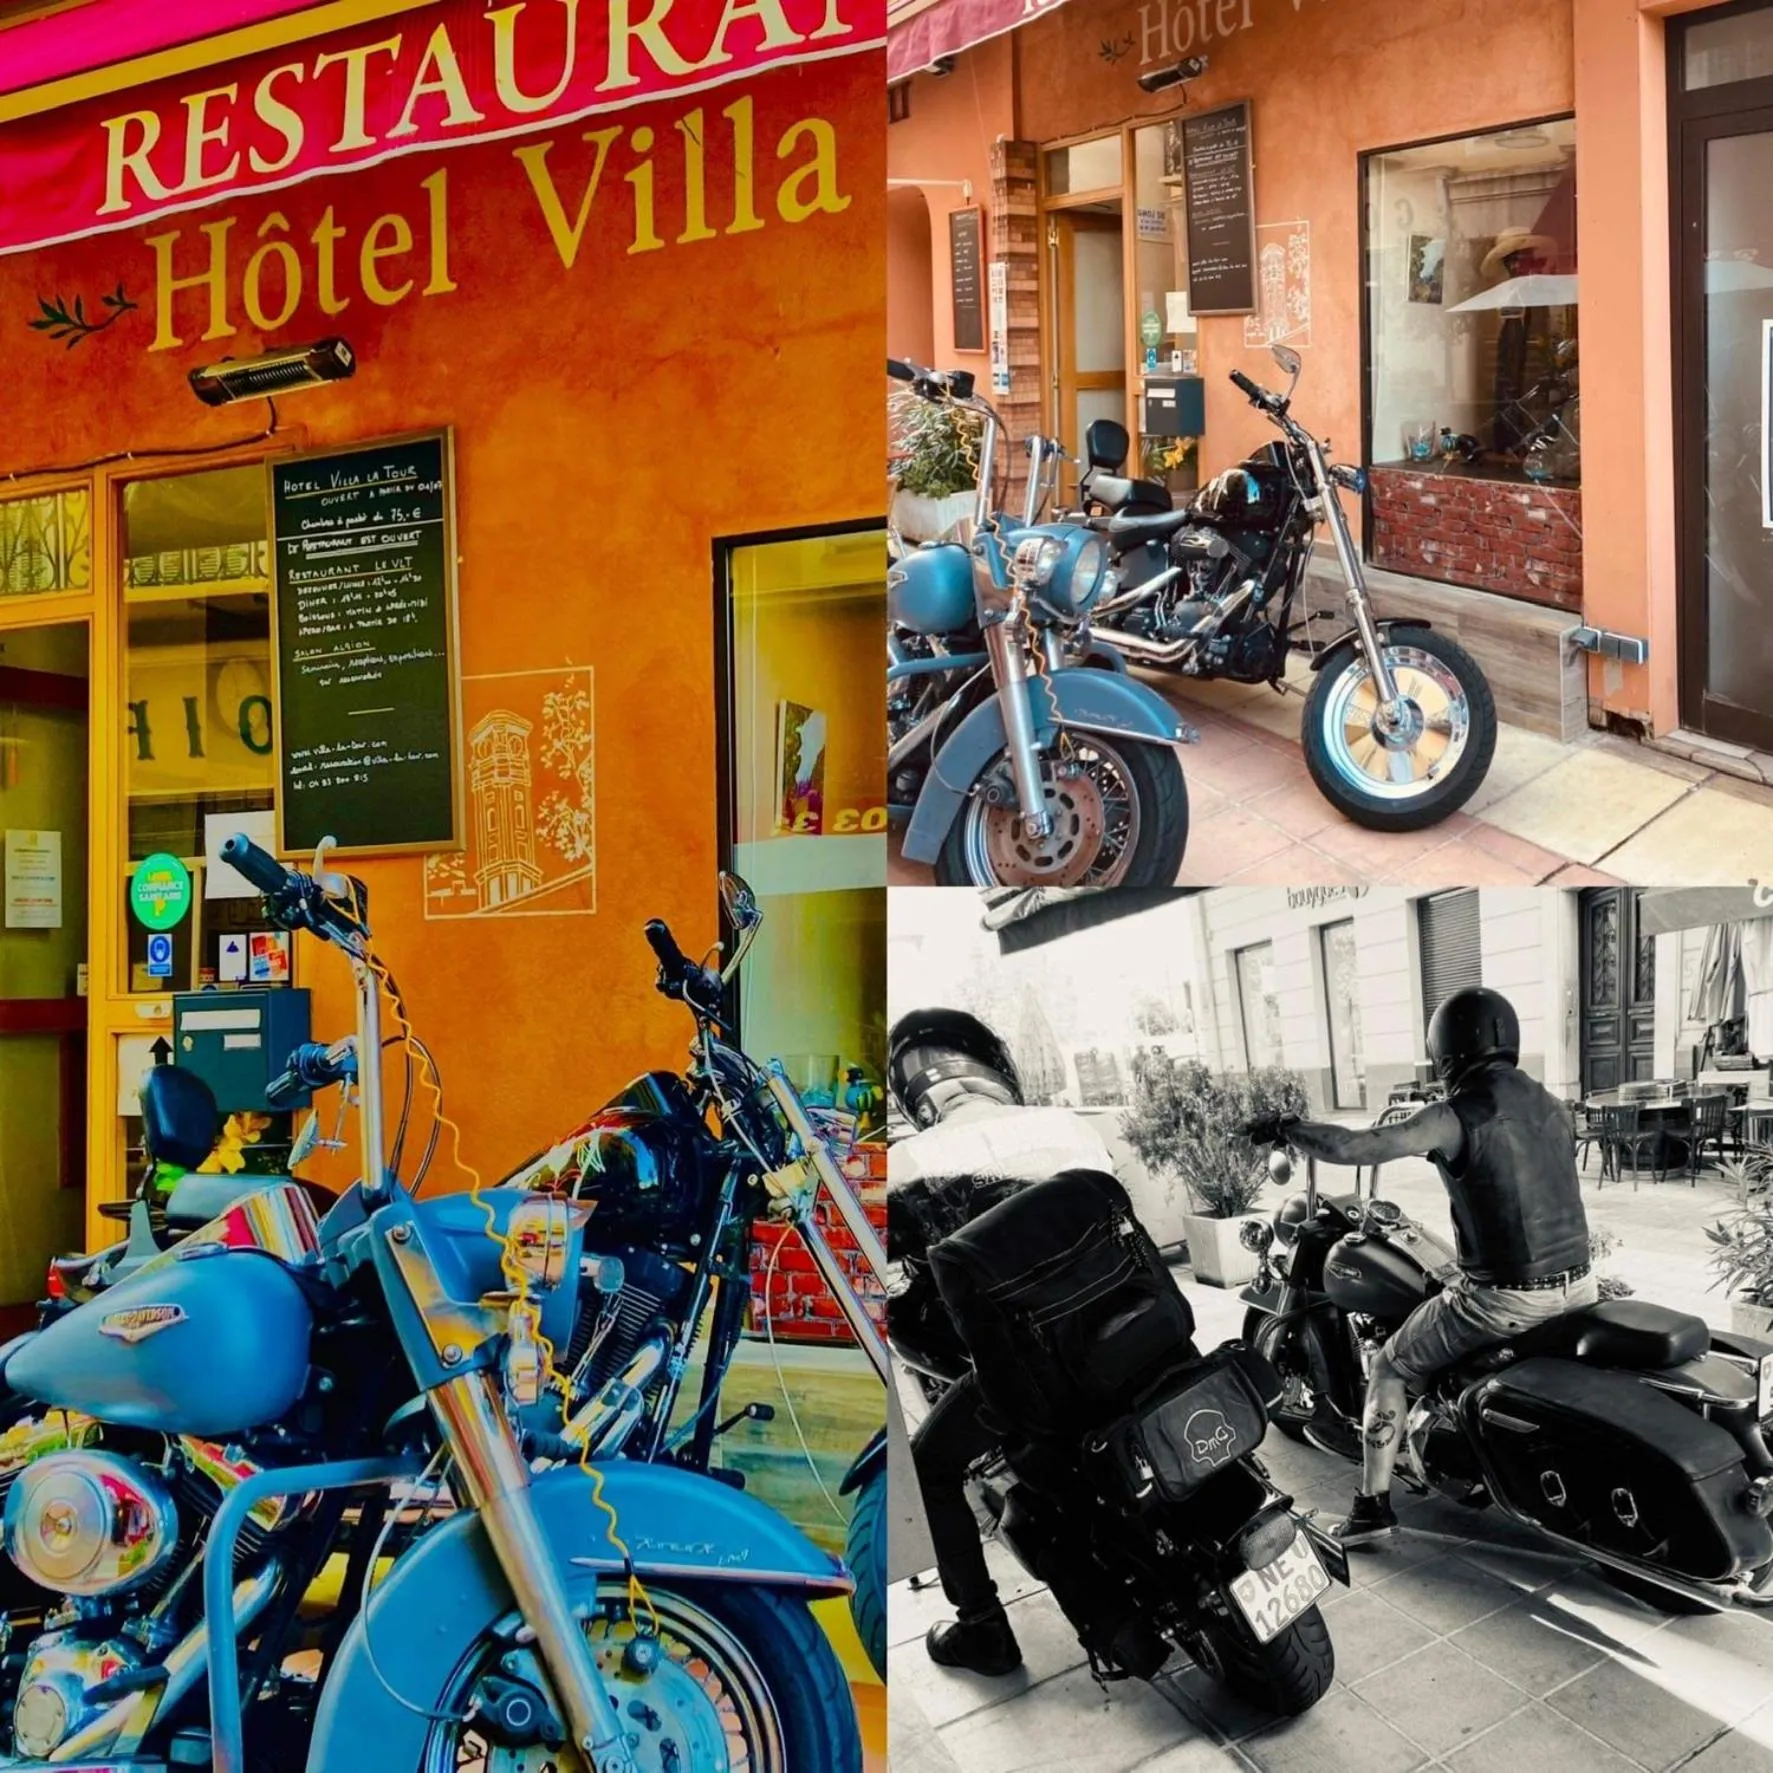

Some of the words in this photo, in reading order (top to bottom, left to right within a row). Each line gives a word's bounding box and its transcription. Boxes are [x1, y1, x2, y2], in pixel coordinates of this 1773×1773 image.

[145, 167, 458, 352] Hôtel
[514, 94, 852, 270] Villa
[367, 471, 380, 483] LA
[383, 464, 417, 478] TOUR
[321, 491, 361, 507] OUVERT
[360, 534, 377, 546] EST
[381, 529, 423, 544] OUVERT
[288, 563, 361, 580] RESTAURANT
[375, 560, 388, 571] LE
[293, 647, 323, 659] SALON
[1257, 1555, 1296, 1594] NE
[1254, 1563, 1328, 1638] 12680
